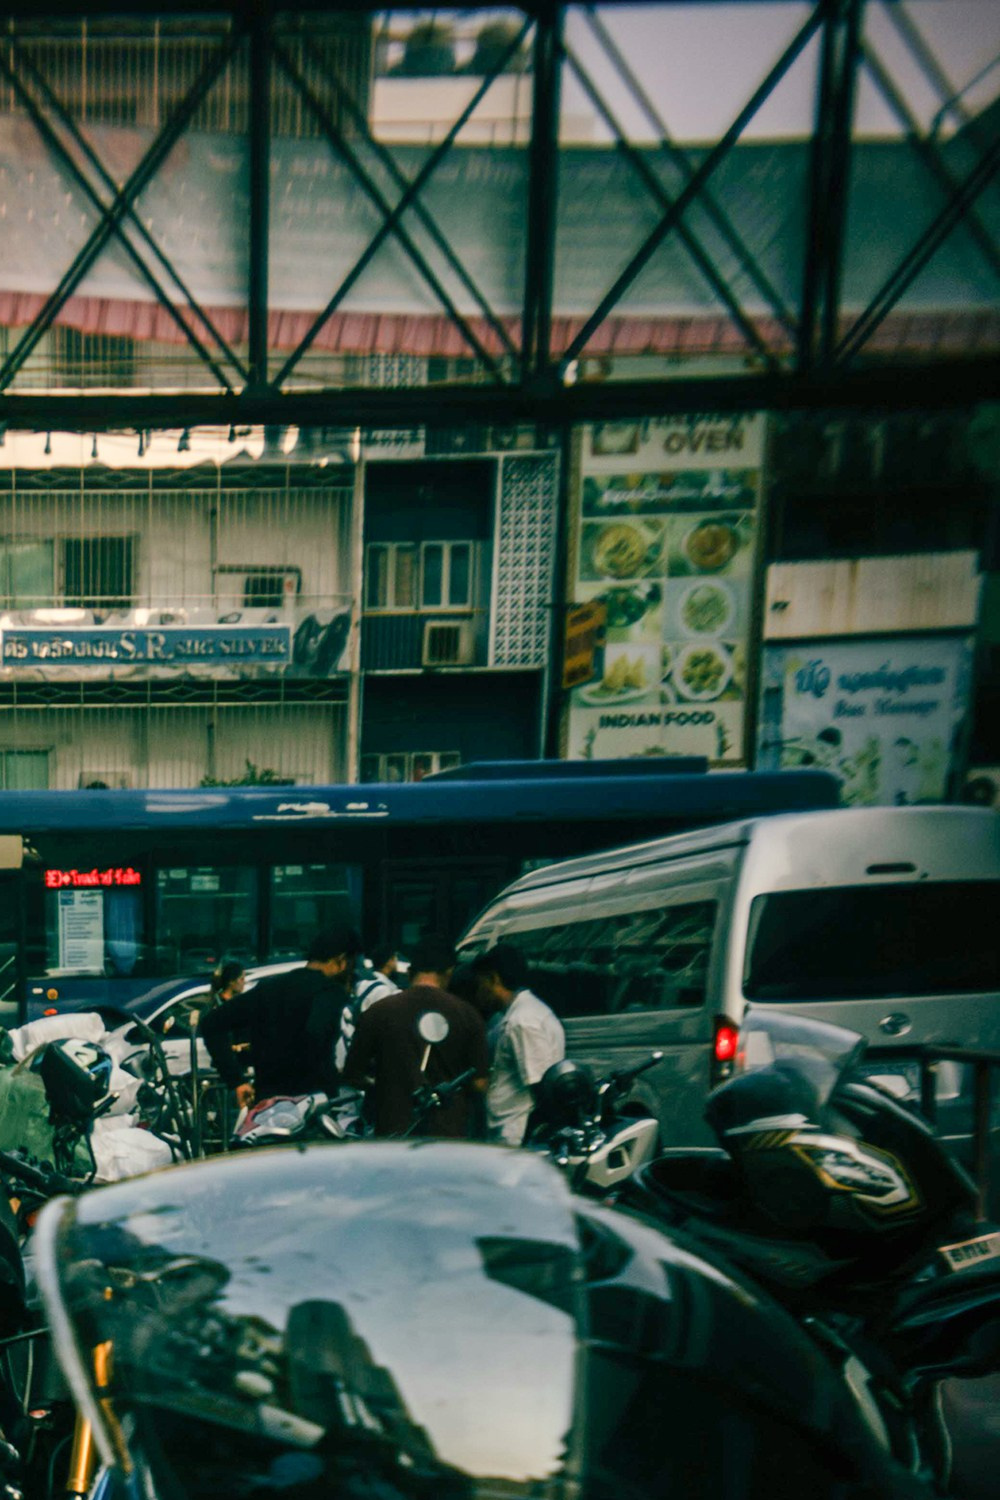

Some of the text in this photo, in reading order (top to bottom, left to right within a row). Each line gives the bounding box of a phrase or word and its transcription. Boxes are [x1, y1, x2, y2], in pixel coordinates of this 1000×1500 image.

[663, 429, 745, 454] OVEN
[600, 711, 715, 728] INDIAN FOOD
